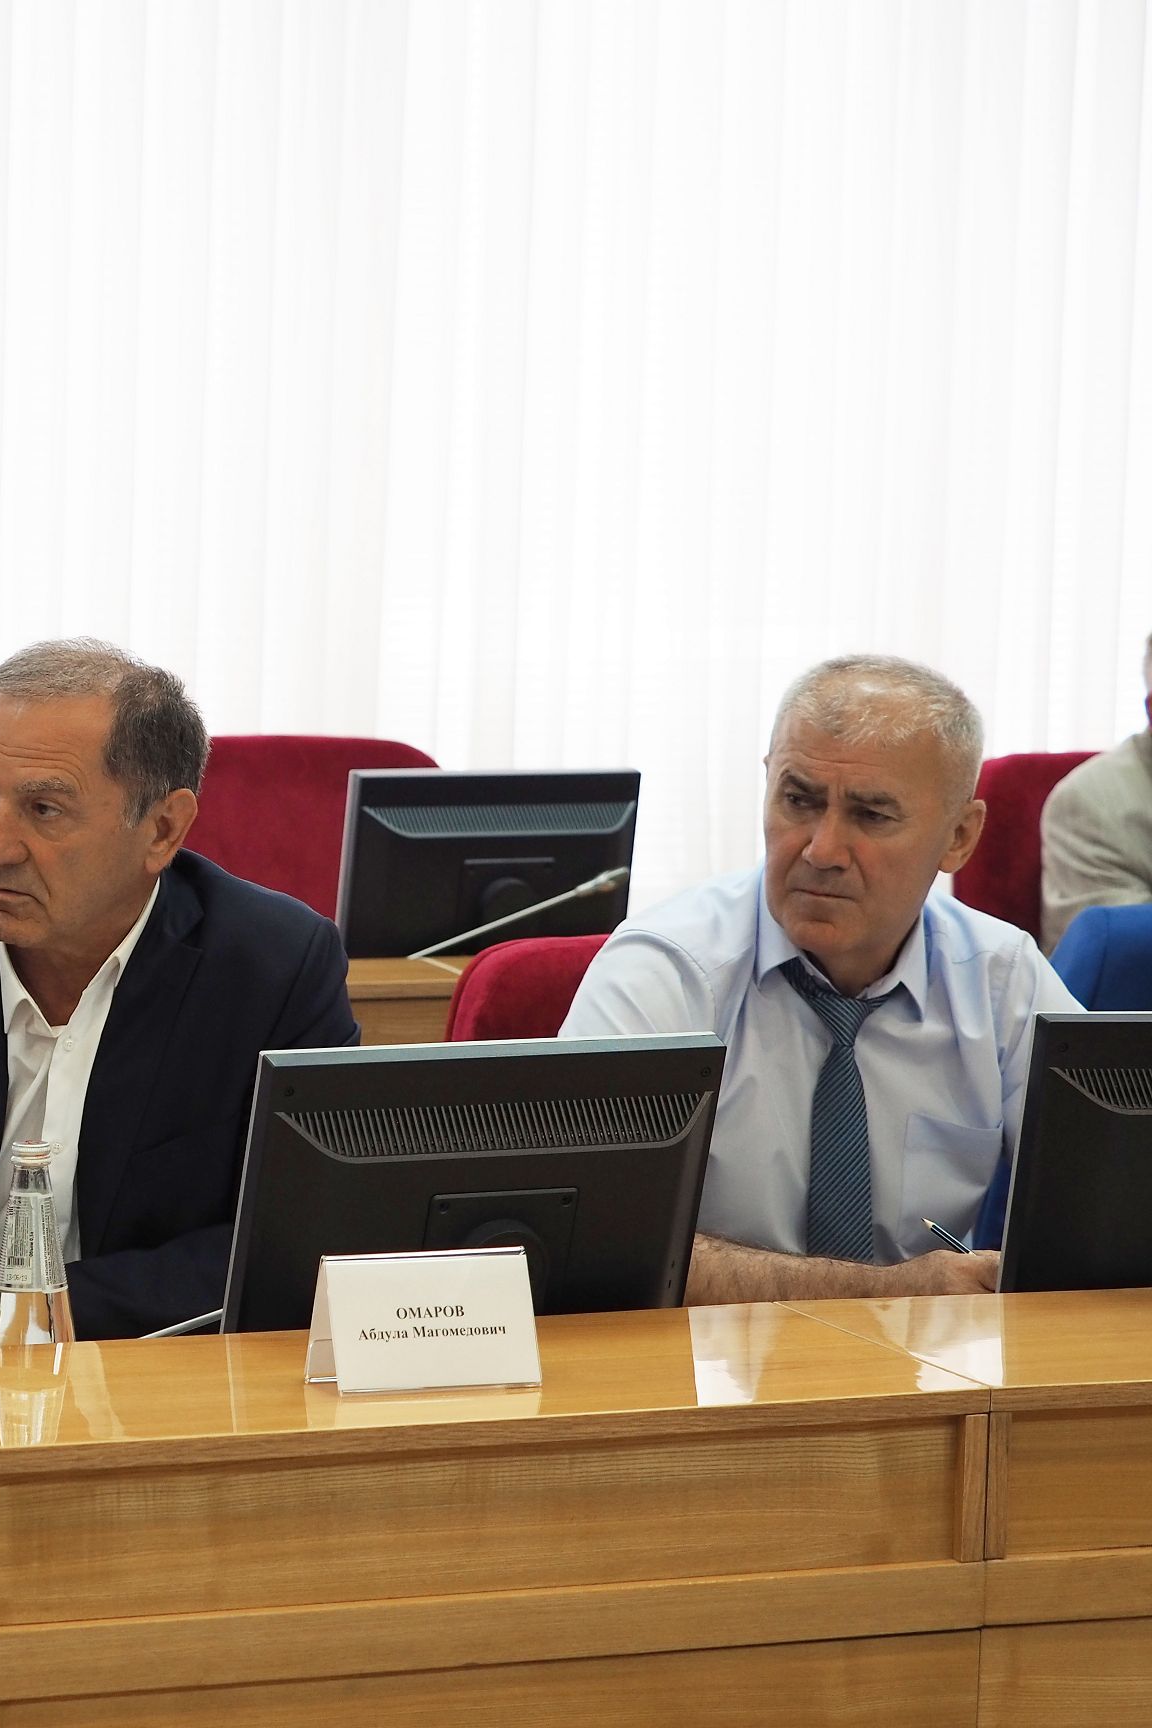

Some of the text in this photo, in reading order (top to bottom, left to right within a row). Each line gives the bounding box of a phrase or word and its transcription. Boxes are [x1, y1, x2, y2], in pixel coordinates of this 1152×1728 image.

[396, 1305, 465, 1319] ОМАРОВ
[358, 1325, 506, 1342] Абдула Магомедович
